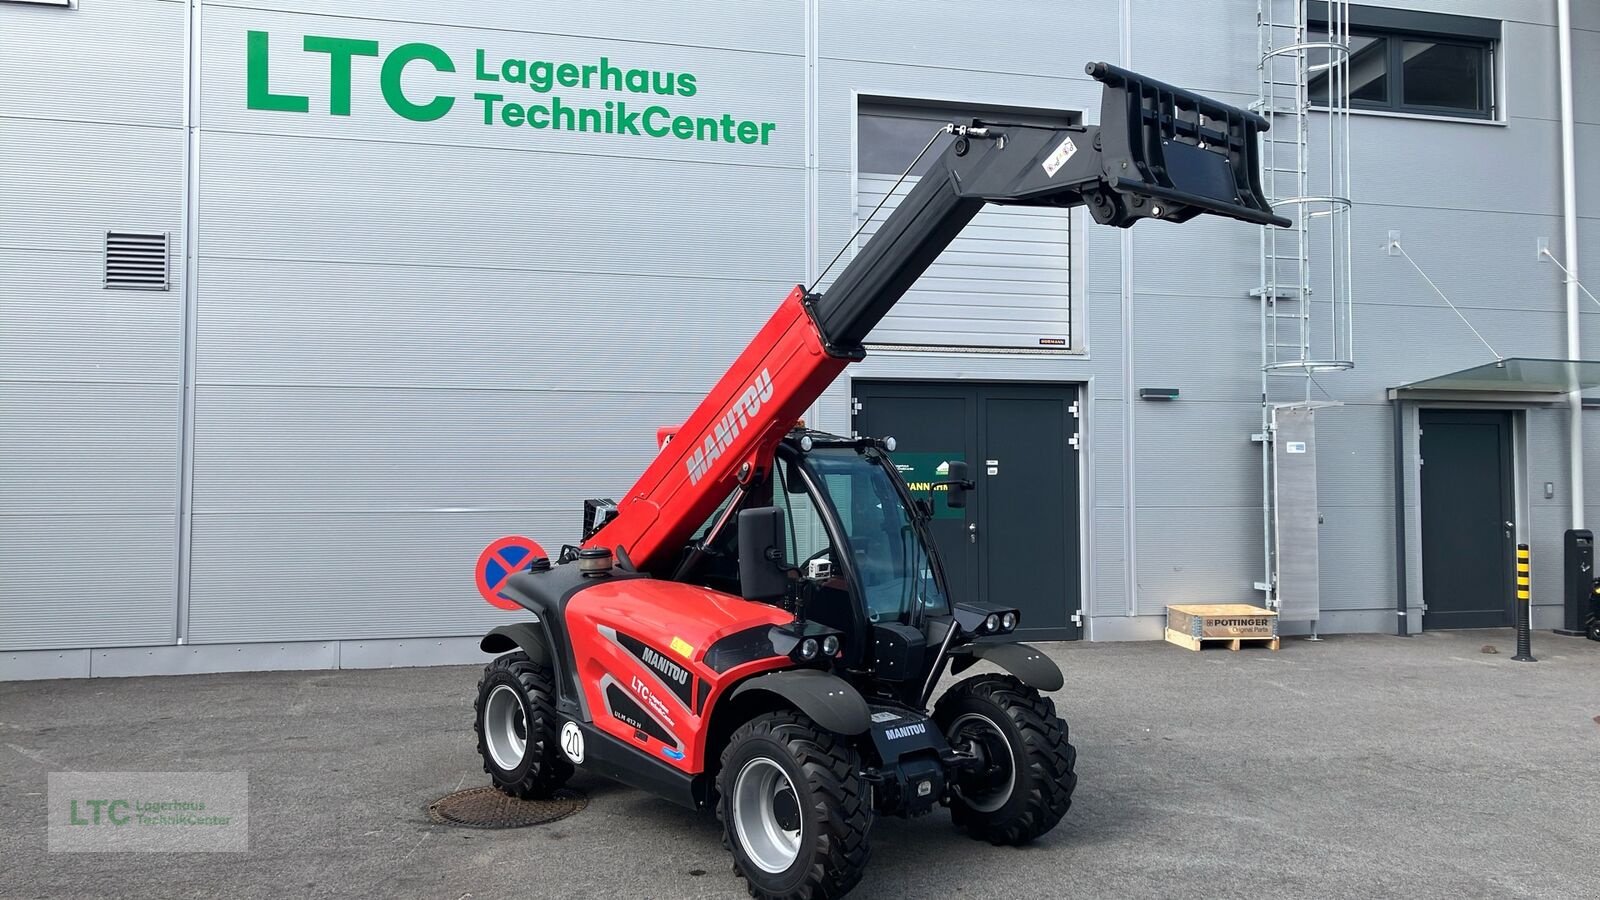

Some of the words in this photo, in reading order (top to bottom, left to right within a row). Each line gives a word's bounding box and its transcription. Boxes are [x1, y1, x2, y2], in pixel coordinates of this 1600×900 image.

[247, 30, 456, 122] LTC
[475, 48, 697, 97] Lagerhaus
[473, 92, 776, 146] TechnikCenter
[686, 367, 774, 486] MANITOU
[641, 647, 689, 685] MANITOU
[631, 675, 649, 700] LTC
[614, 710, 626, 721] ULM
[626, 717, 636, 726] 412
[885, 723, 926, 740] MANITOU
[565, 730, 580, 757] 20
